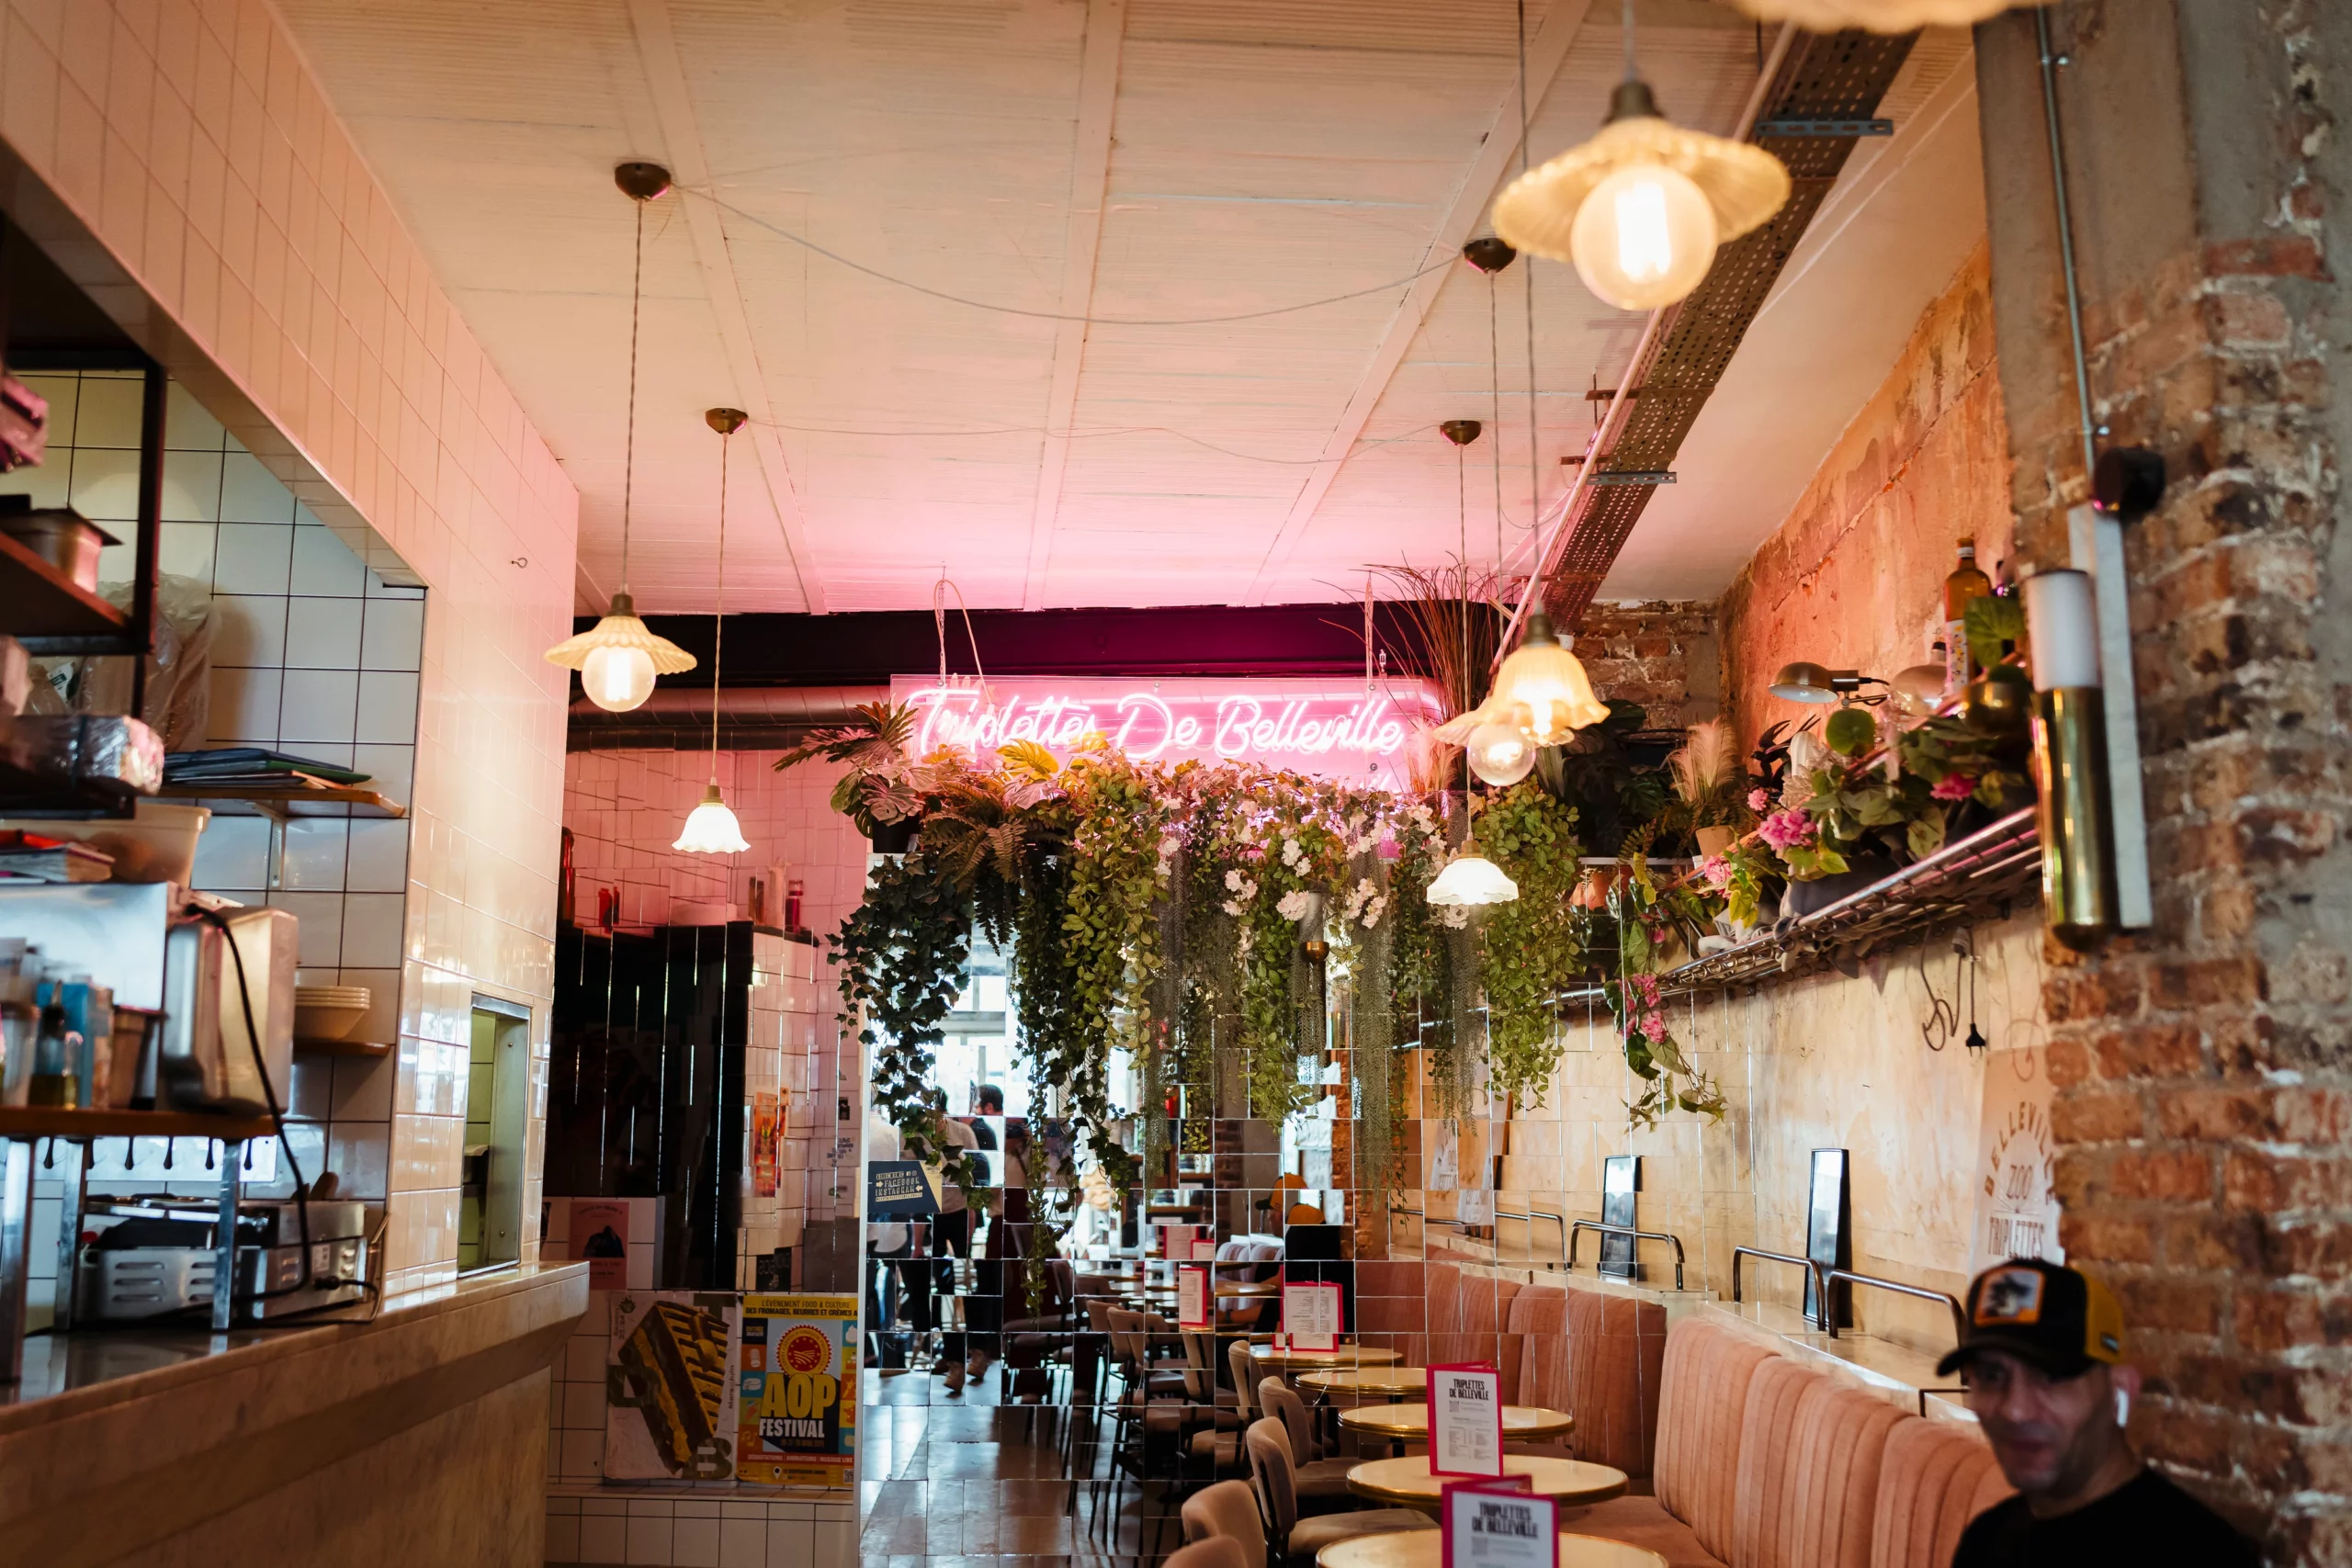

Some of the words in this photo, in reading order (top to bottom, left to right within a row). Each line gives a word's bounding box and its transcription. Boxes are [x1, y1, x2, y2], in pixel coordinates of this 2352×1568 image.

[1117, 694, 1203, 761] De
[1215, 694, 1406, 759] Belleville
[876, 1185, 915, 1197] INSTAGRAM
[885, 1177, 920, 1188] FACEBOOK
[2007, 1164, 2033, 1201] ZOO
[793, 1308, 820, 1316] BEURRES
[802, 1300, 818, 1309] FOOD
[825, 1301, 851, 1310] CULTURE
[1453, 1378, 1485, 1391] TRIPLETTES
[761, 1372, 837, 1419] AOP
[1449, 1388, 1458, 1398] DE
[1458, 1389, 1489, 1402] BELLEVILLE
[759, 1418, 825, 1438] FESTIVAL
[1479, 1501, 1532, 1521] TRIPLETTES
[1472, 1516, 1484, 1533] DE
[1487, 1517, 1538, 1540] BELLEVILLE
